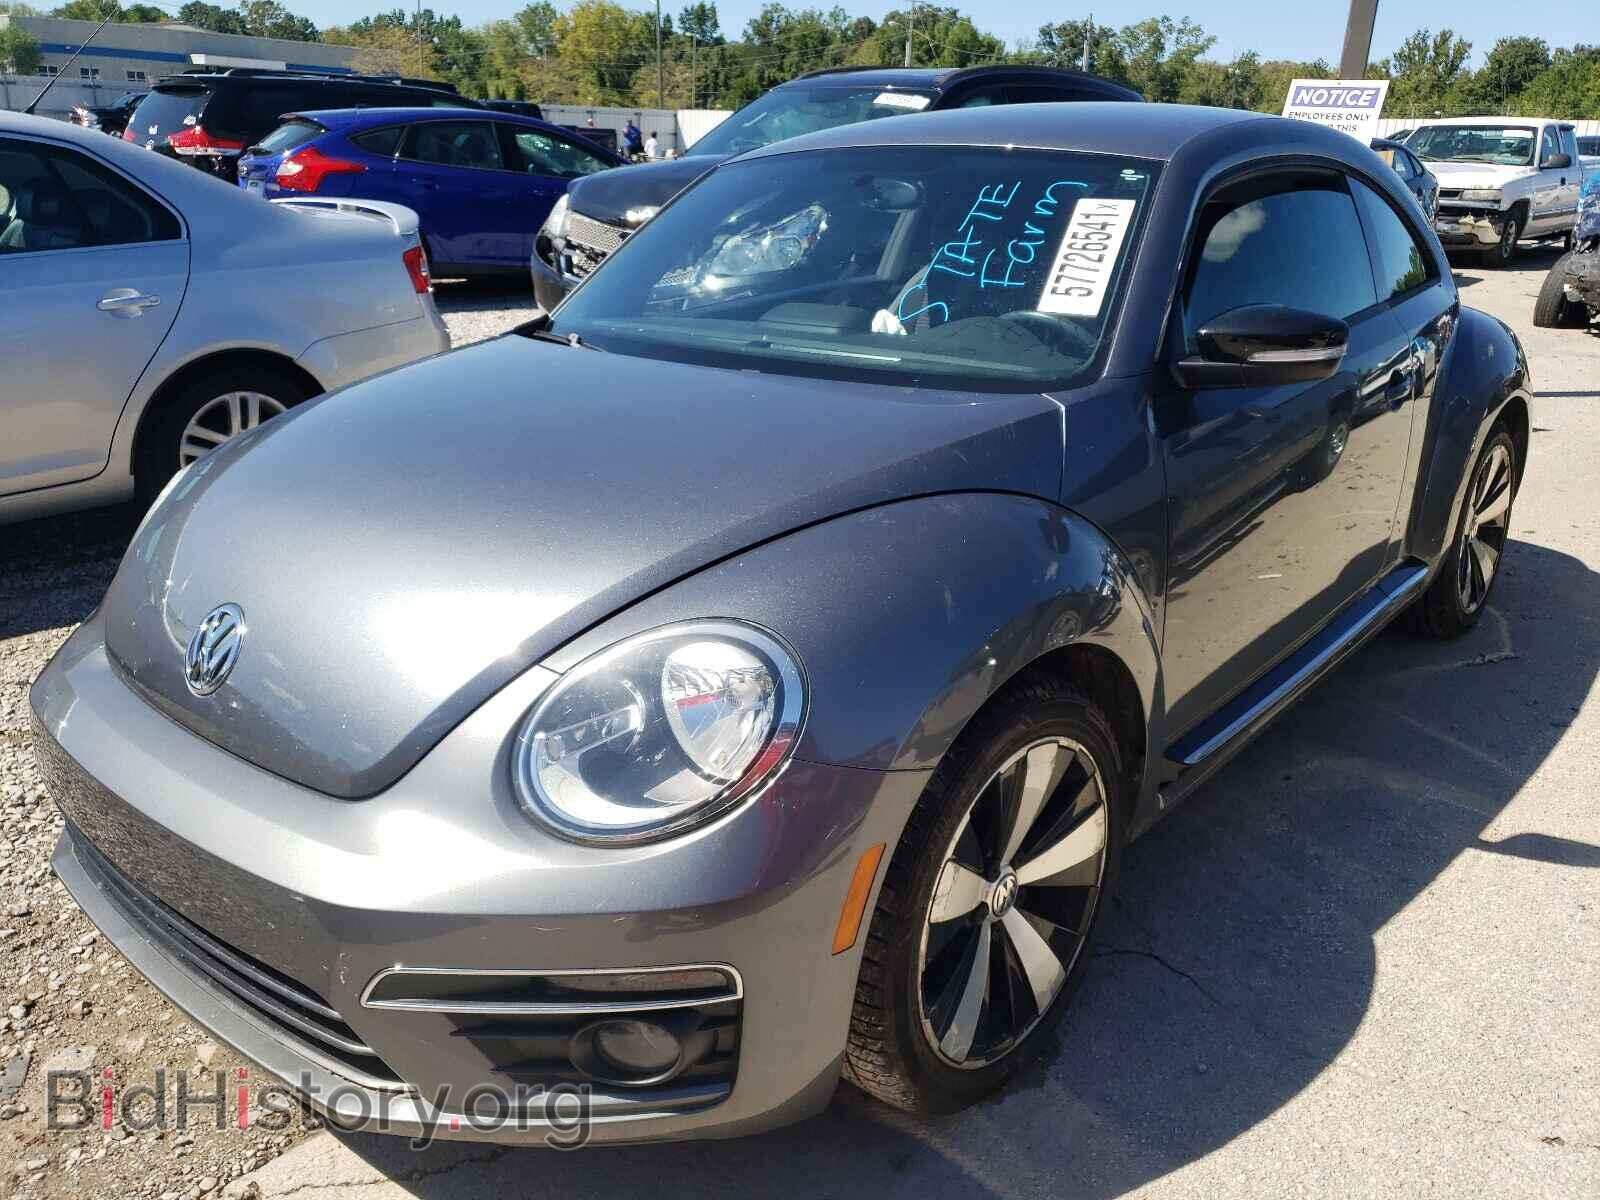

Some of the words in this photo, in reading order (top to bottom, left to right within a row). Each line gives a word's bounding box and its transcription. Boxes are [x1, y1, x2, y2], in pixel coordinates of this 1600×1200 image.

[1288, 111, 1343, 121] EMPLOYEES
[1346, 112, 1372, 121] ONLY
[1295, 88, 1376, 106] NOTICE
[1336, 124, 1357, 133] THIS
[898, 181, 1021, 321] STATE
[980, 182, 1089, 288] Farm
[1050, 212, 1120, 297] 57726541
